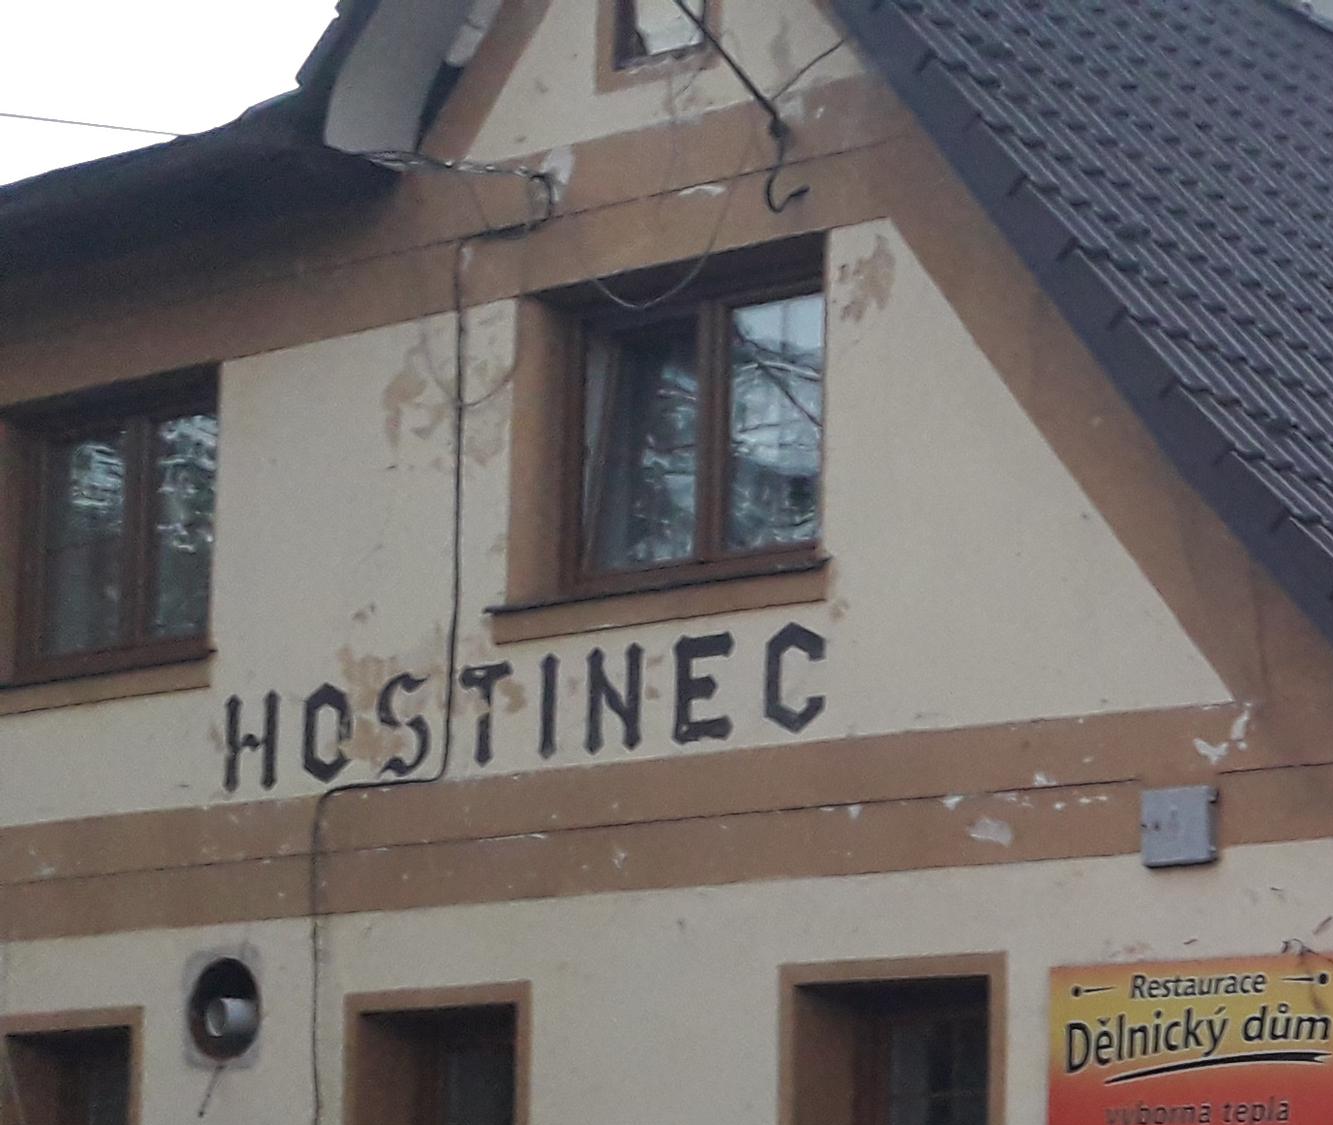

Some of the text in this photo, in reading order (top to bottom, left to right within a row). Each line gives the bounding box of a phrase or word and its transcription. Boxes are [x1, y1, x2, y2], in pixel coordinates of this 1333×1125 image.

[223, 621, 827, 793] HOSTINEC
[1130, 972, 1268, 999] Restaurace
[1064, 1003, 1333, 1074] Dělnický dům
